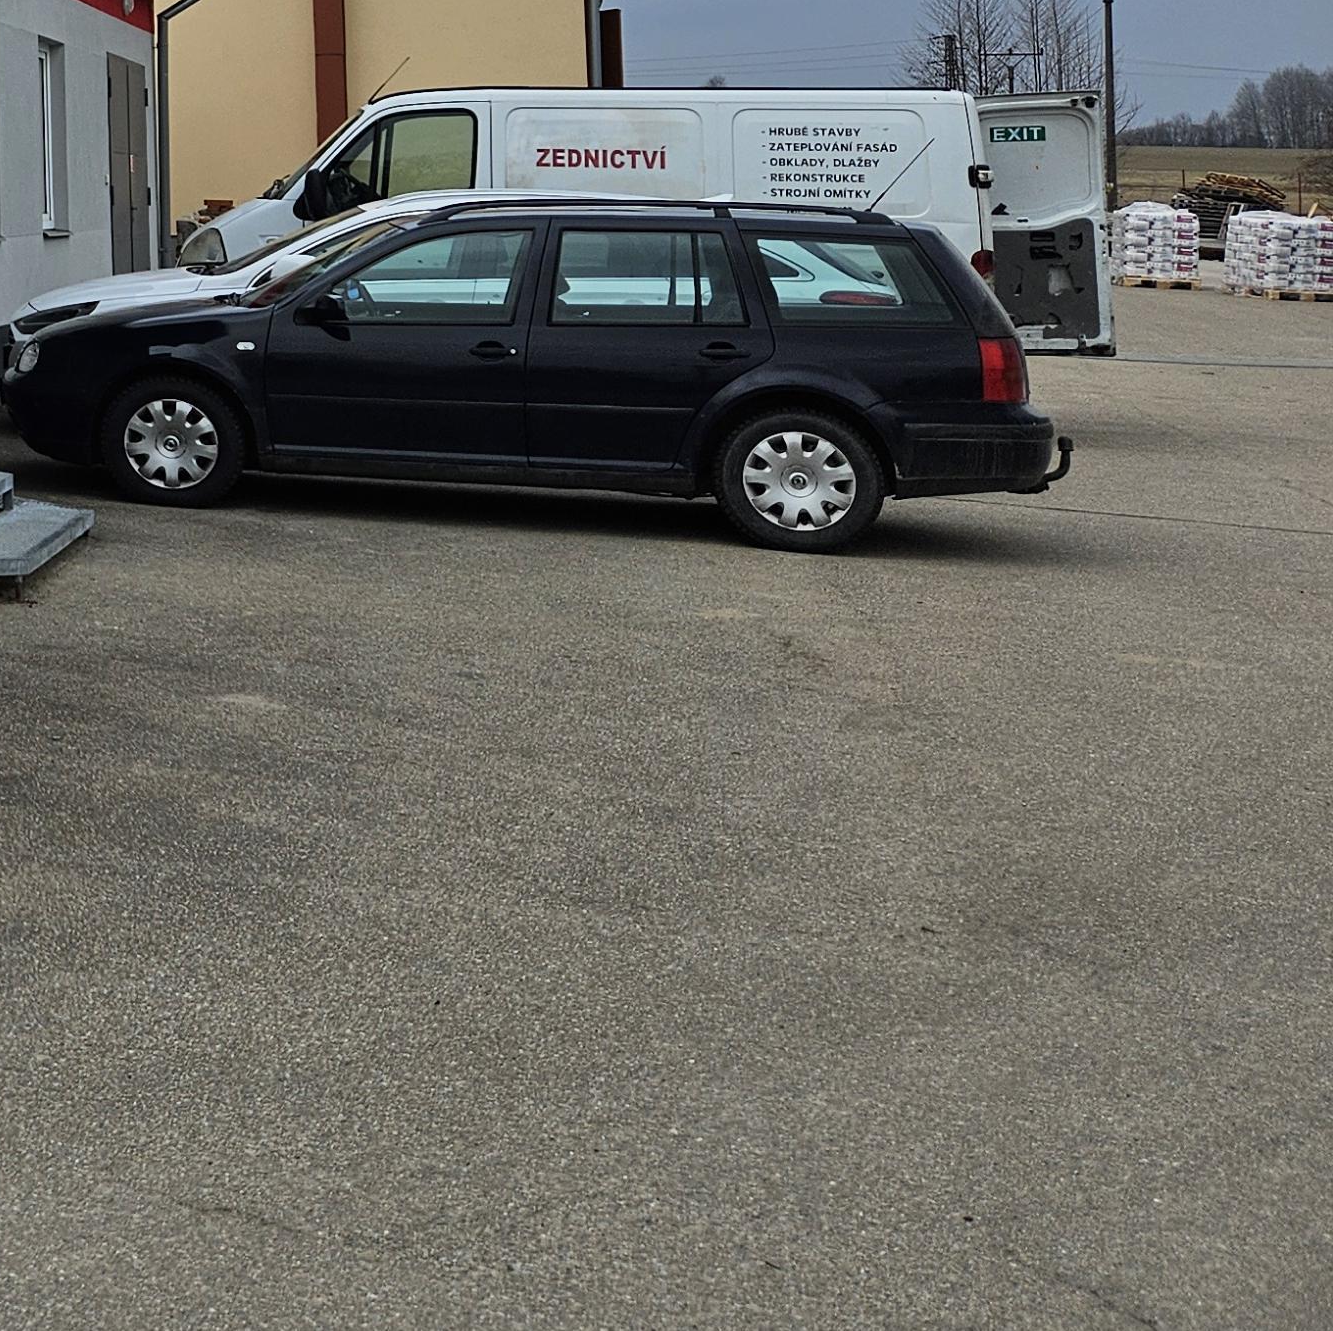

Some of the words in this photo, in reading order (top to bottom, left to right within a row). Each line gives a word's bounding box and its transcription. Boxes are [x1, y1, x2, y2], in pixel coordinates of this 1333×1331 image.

[769, 126, 809, 136] HRUBÉ
[812, 127, 861, 137] STAVBY
[993, 127, 1042, 141] EXIT
[769, 141, 853, 152] ZATEPLOVÁNÍ
[856, 142, 898, 152] FASÁD
[536, 146, 666, 170] ZEDNICTVÍ
[769, 157, 829, 168] OBKLADY,
[833, 156, 880, 167] DLAŽBY
[770, 172, 866, 183] REKONSTRUKCE
[770, 187, 821, 198] STROJNÍ
[823, 188, 871, 199] OMÍTKY
